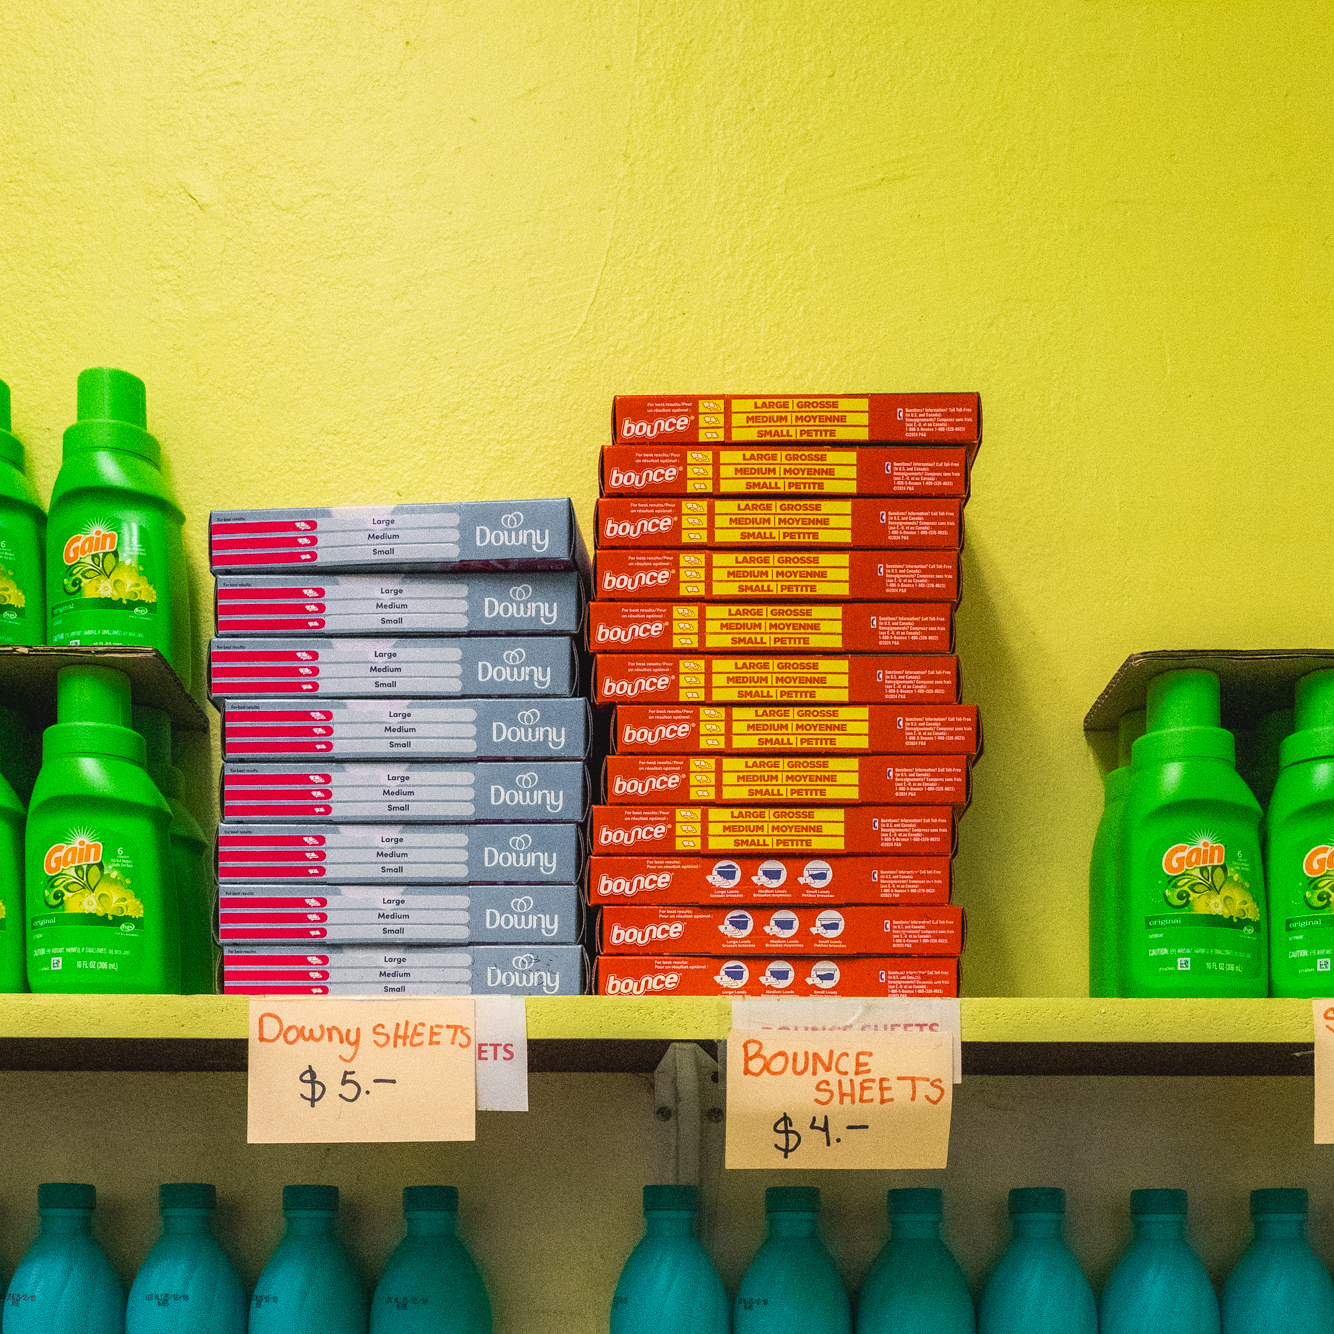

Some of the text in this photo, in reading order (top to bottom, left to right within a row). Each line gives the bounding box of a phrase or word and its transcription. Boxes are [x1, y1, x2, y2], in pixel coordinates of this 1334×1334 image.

[754, 400, 839, 410] LARGE GROSSE
[622, 415, 690, 439] bounce
[746, 414, 847, 424] MEDIUM MOYENNE
[756, 429, 837, 438] SMALL PETITE
[372, 517, 395, 526] Large
[367, 532, 400, 540] Medium
[475, 525, 549, 552] Downy
[372, 547, 395, 556] Small
[597, 621, 663, 645] bounce
[731, 636, 810, 645] SMALL PETITE
[477, 661, 551, 689] Downy
[491, 785, 563, 813] Downy
[600, 823, 667, 846] bounce
[1162, 842, 1225, 875] Gain
[485, 908, 558, 936] Downy
[610, 920, 685, 945] bounce
[1148, 918, 1181, 927] original
[258, 1012, 472, 1063] Downy SHEETS
[742, 1039, 873, 1076] BOUNCE
[813, 1076, 945, 1106] SHEETS
